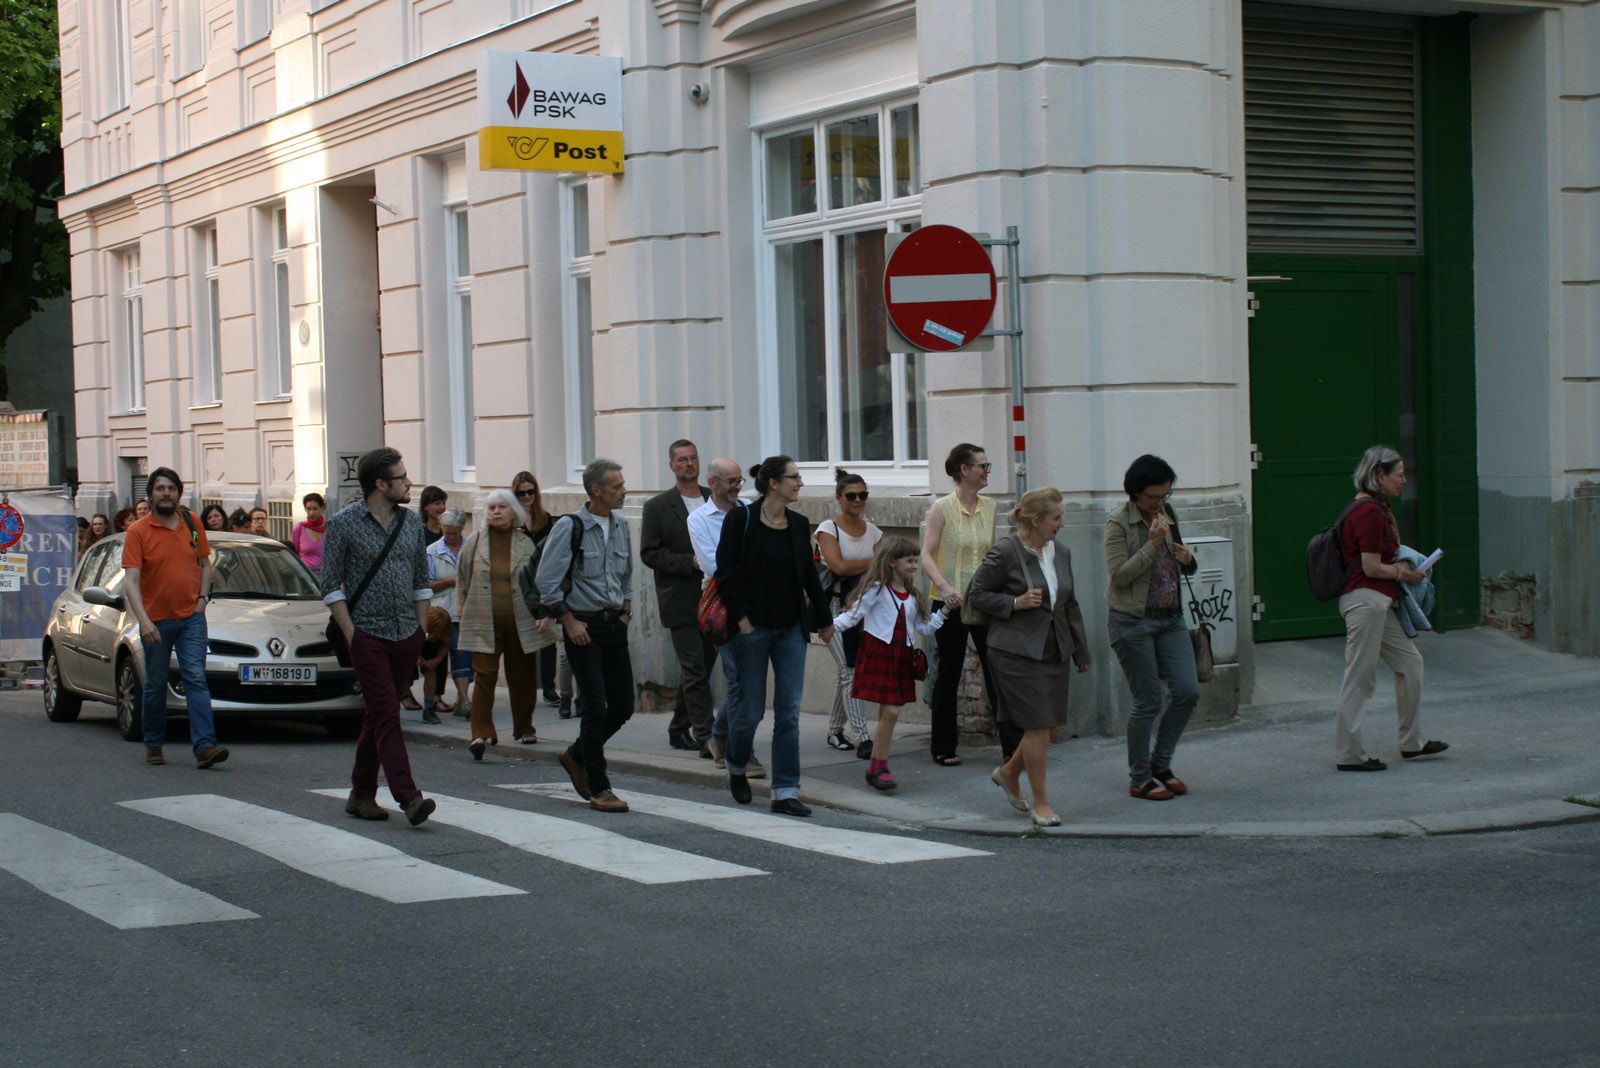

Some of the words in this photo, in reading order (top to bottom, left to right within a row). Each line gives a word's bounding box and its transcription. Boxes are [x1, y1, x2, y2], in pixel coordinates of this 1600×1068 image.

[533, 90, 606, 105] BAWAG
[533, 104, 576, 119] PSK
[554, 142, 608, 160] Post
[11, 533, 73, 552] REN
[271, 668, 302, 680] 16819
